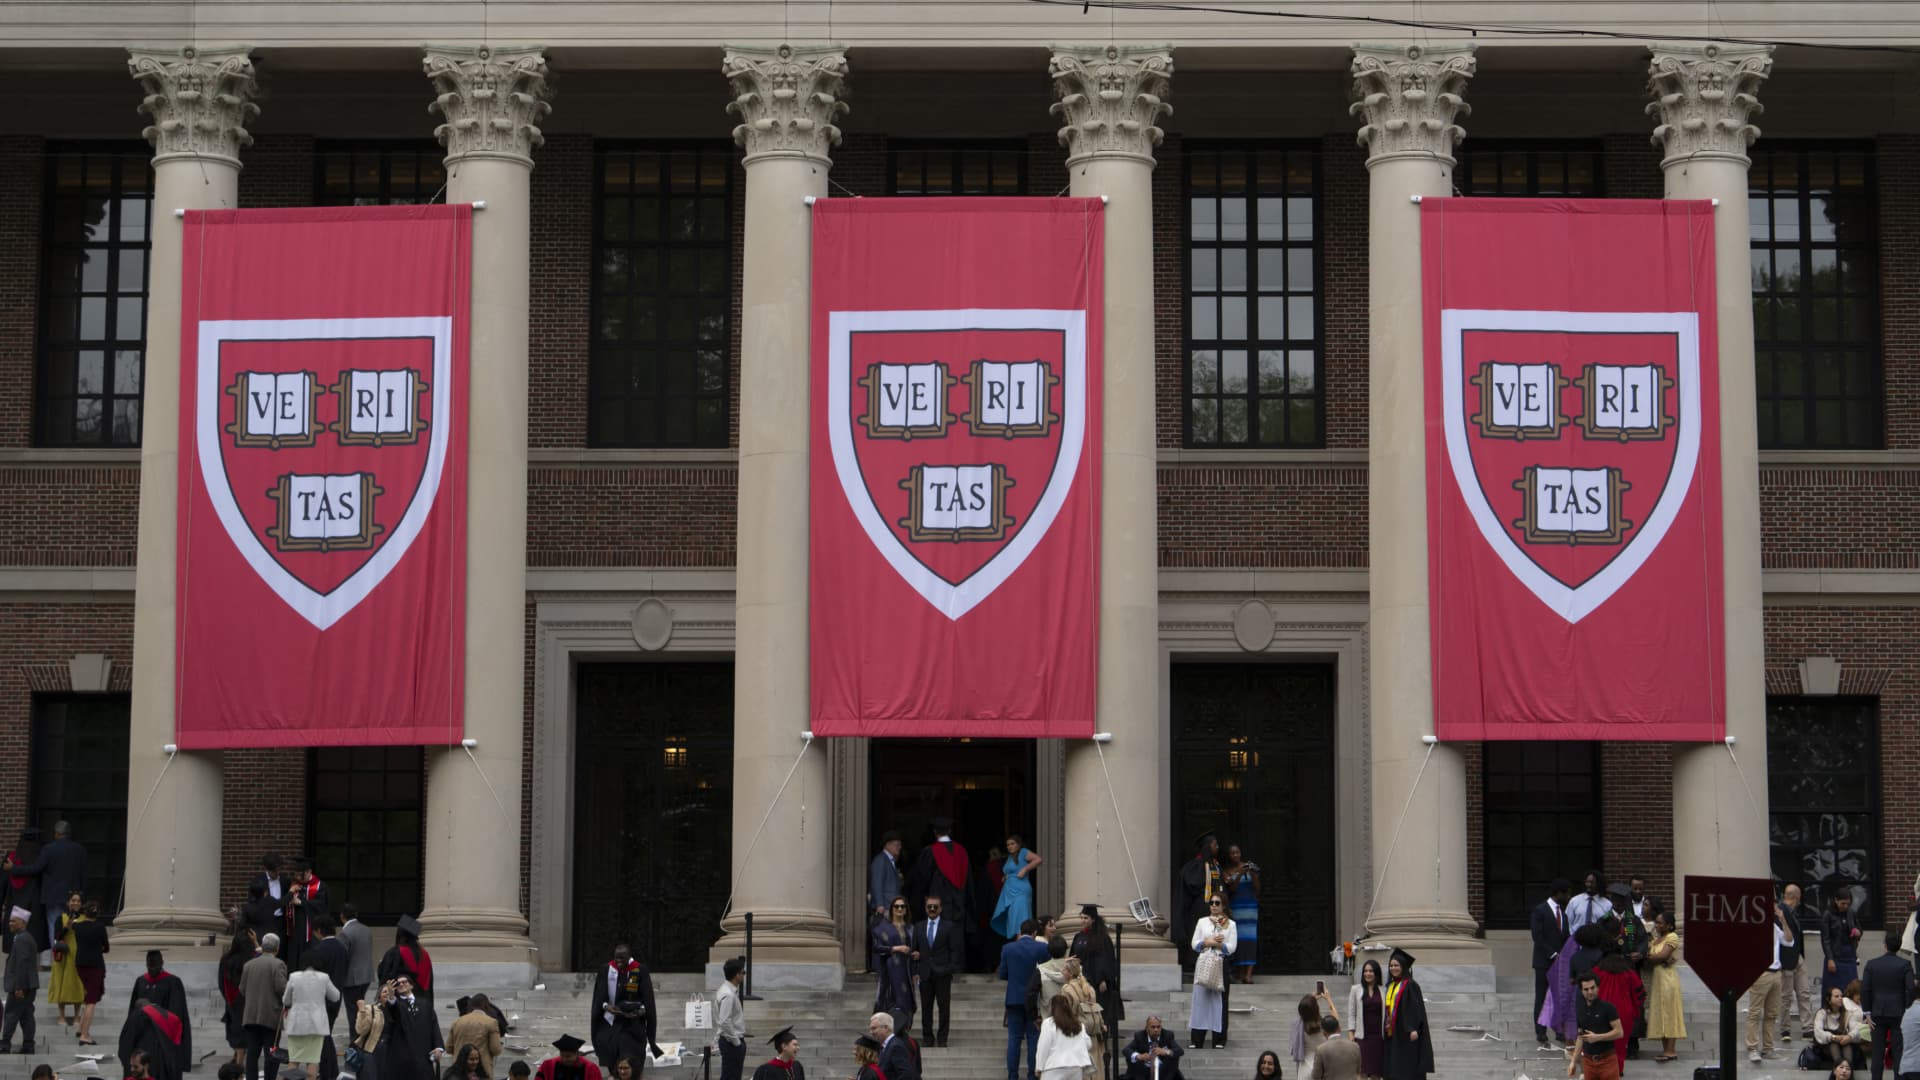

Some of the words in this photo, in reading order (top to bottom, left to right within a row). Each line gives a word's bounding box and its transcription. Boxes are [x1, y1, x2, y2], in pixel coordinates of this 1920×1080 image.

[251, 391, 296, 420] VE
[356, 389, 394, 418] RI
[882, 382, 928, 411] VE
[987, 380, 1025, 409] RI
[1495, 382, 1541, 411] VE
[1600, 384, 1639, 413] RI
[297, 491, 354, 520] TAS
[930, 482, 985, 511] TAS
[1544, 484, 1602, 514] TAS
[1689, 892, 1767, 924] HMS
